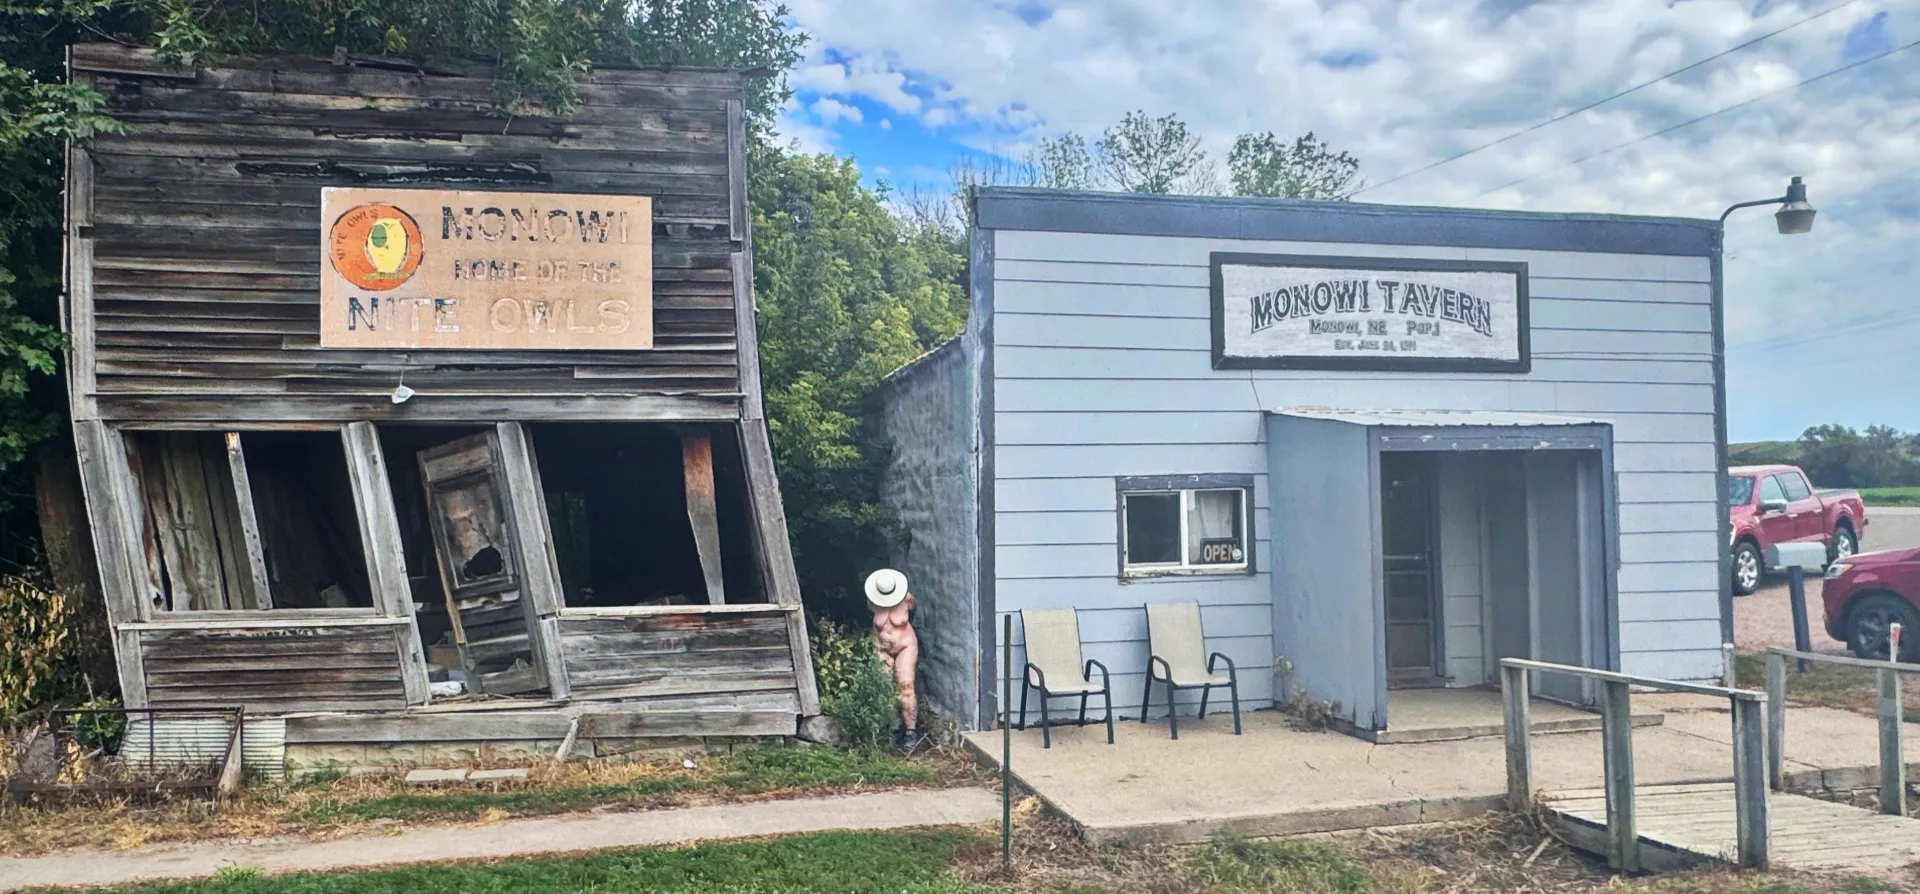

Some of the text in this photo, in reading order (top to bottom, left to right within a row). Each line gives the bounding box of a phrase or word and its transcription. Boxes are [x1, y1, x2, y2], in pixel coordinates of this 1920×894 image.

[441, 206, 628, 244] MONOWI
[454, 259, 622, 283] HOME OF THE
[348, 297, 631, 334] NITE OWLS
[1250, 280, 1493, 337] MONOWI TAVERN
[1367, 319, 1388, 335] NE
[1203, 544, 1239, 562] OPEN
